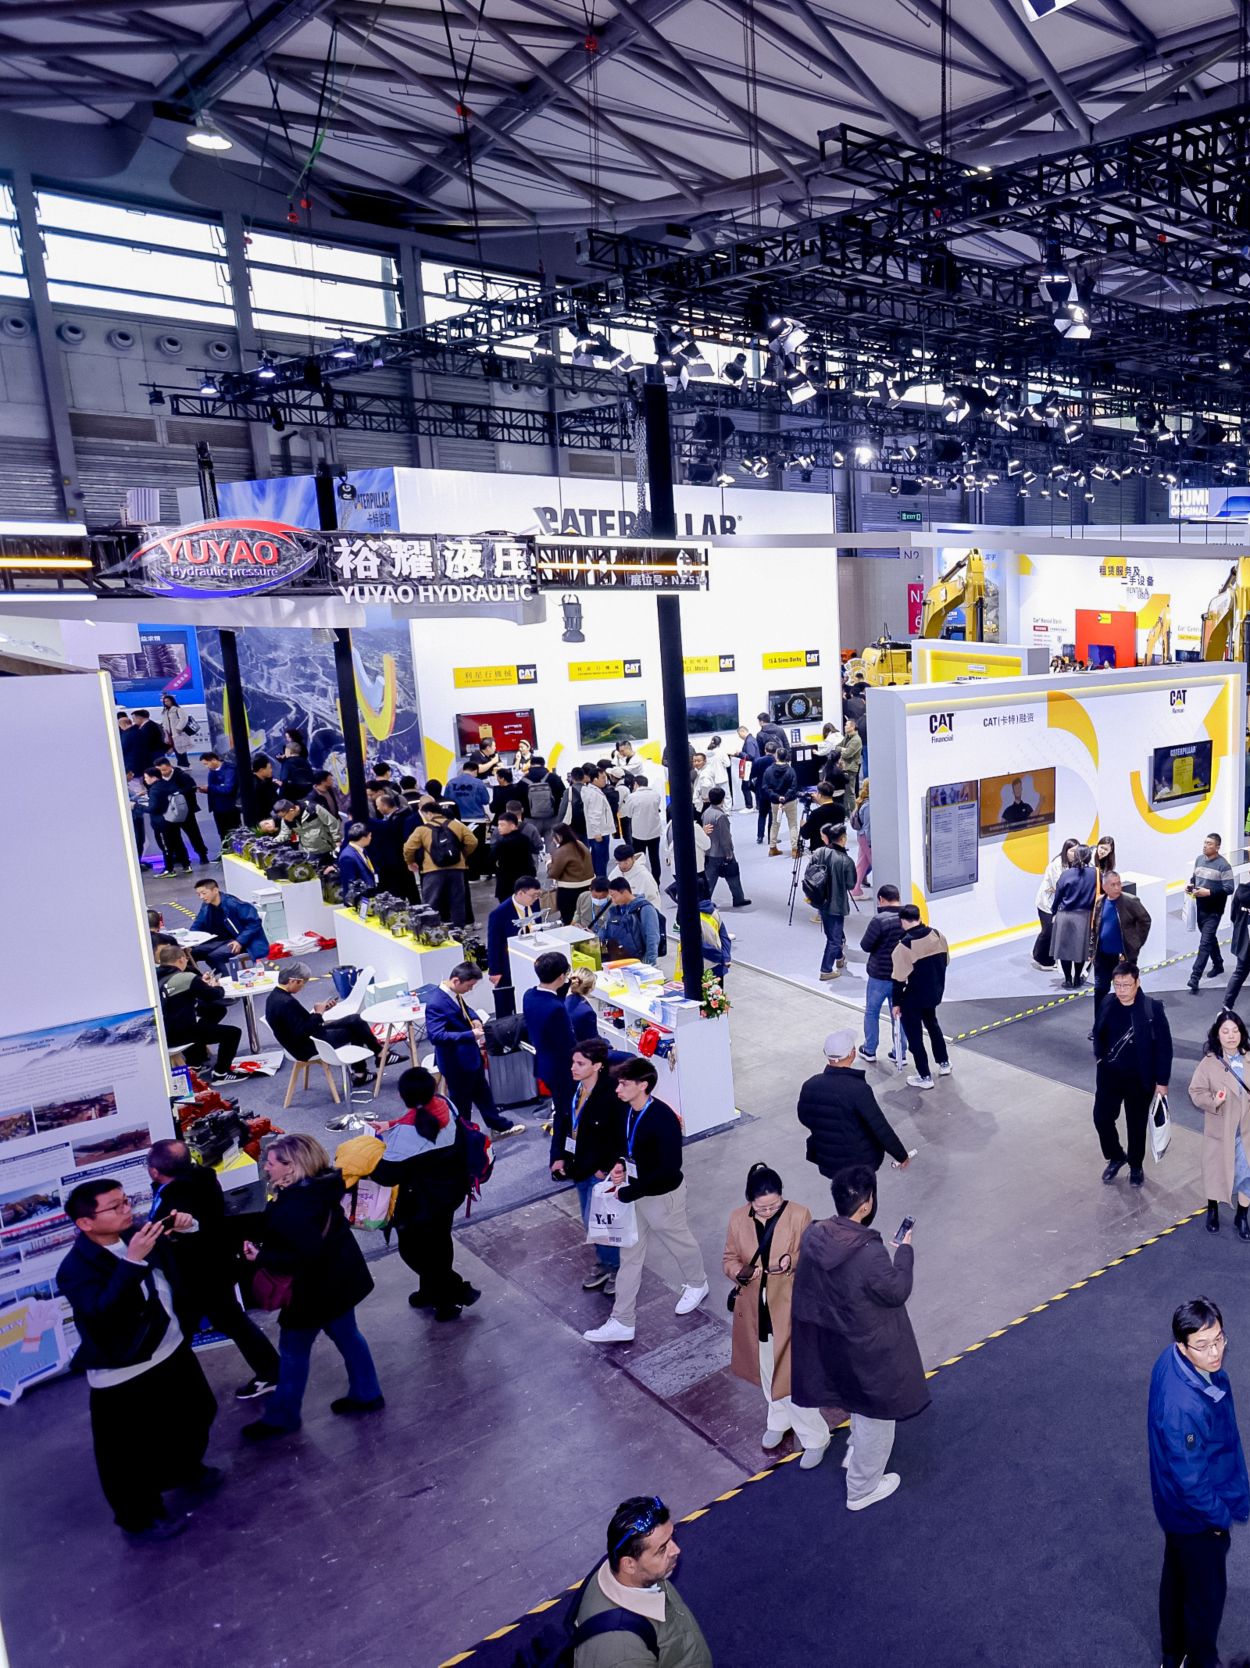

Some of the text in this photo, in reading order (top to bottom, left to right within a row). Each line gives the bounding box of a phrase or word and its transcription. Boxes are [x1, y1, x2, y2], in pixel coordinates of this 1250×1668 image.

[1170, 488, 1209, 506] IZUMI
[161, 540, 280, 565] YUYAO
[334, 538, 530, 580] 裕耀液压
[170, 566, 279, 578] Hydraulic pressure
[1099, 565, 1141, 577] 租赁服务及
[1121, 576, 1154, 587] 二手设备
[339, 584, 533, 604] YUYAO HYDRAULIC
[720, 658, 734, 668] CAT
[806, 653, 820, 662] CAT
[518, 668, 536, 680] CAT
[624, 663, 641, 674] CAT
[1169, 689, 1187, 706] CAT
[929, 712, 955, 734] CAT
[931, 735, 954, 744] Financial
